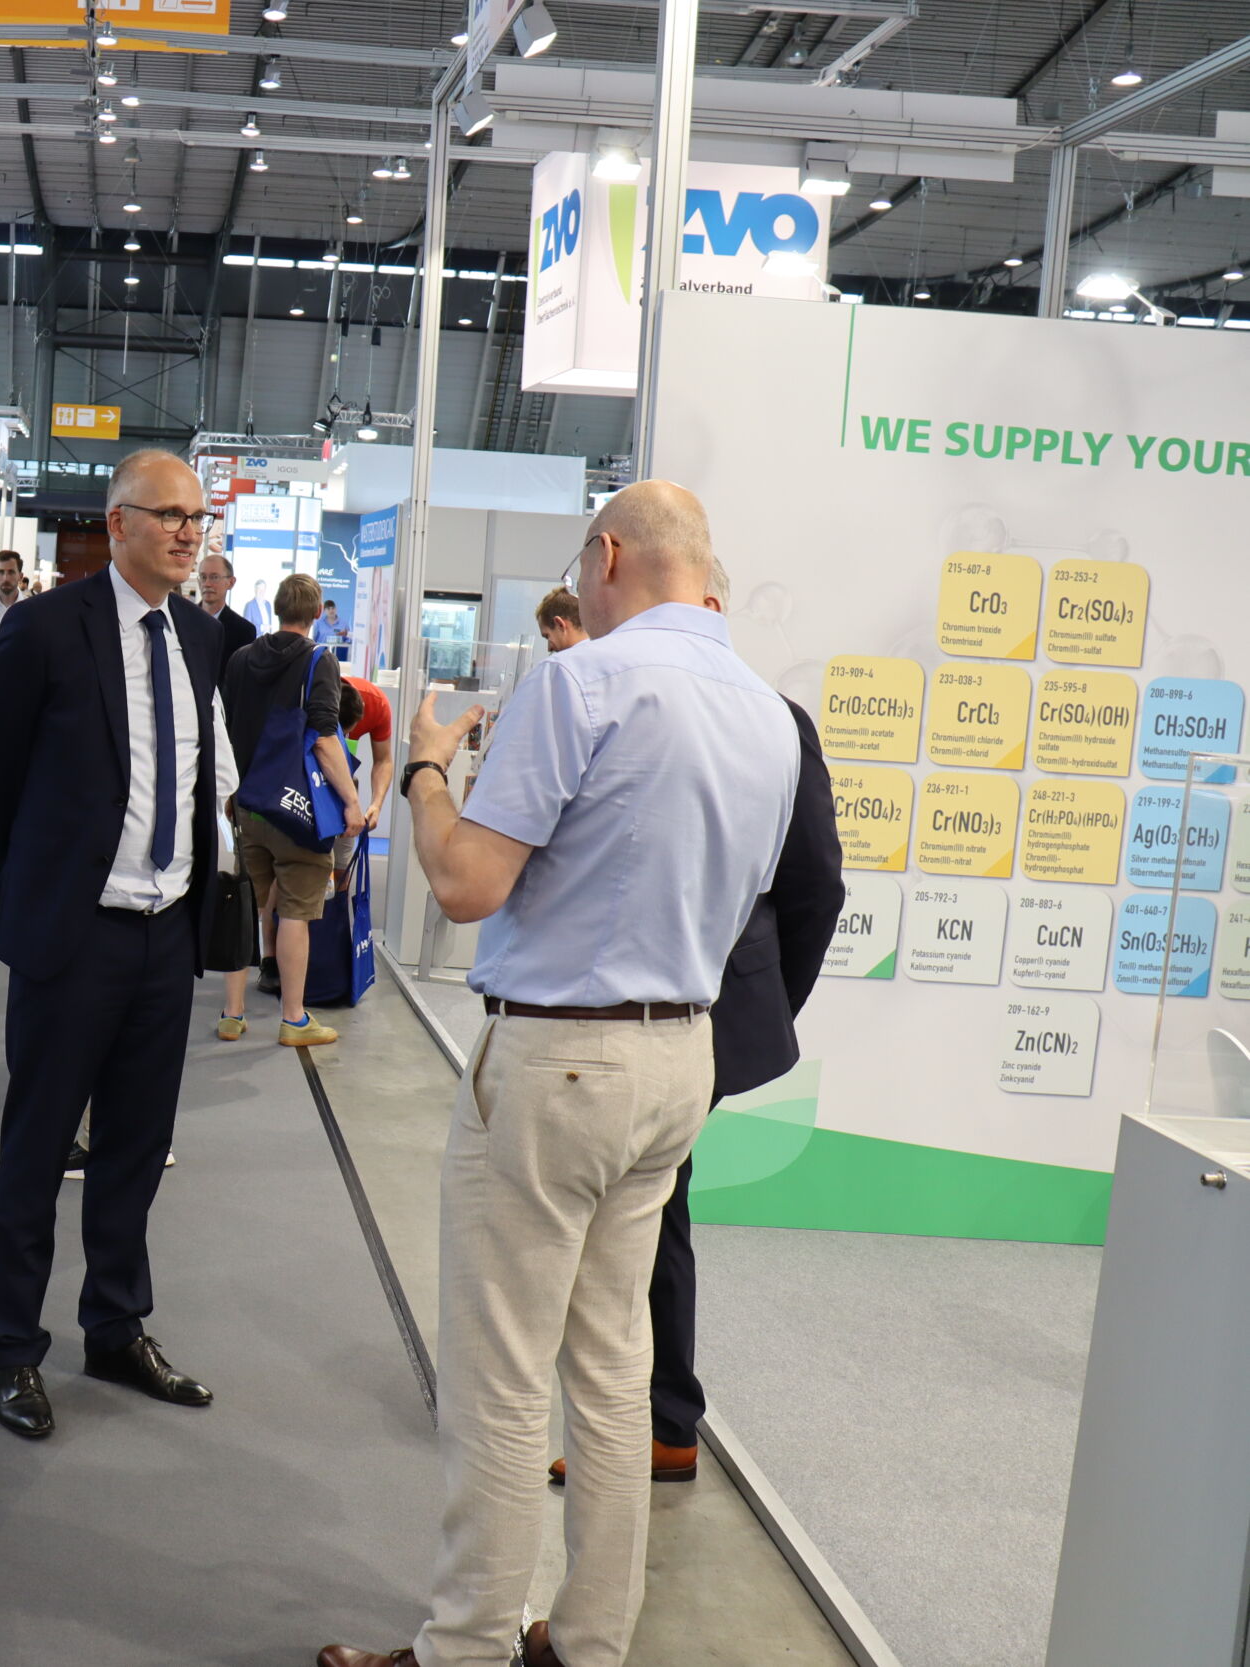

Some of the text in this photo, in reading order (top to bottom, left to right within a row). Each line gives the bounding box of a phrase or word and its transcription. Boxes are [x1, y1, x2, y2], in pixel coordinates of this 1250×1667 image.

[540, 188, 581, 273] ZVO
[860, 415, 1250, 477] WE SUPPLY YOUR
[246, 458, 268, 467] ZVO
[948, 562, 991, 575] 215-607-8
[1055, 570, 1098, 583] 233-253-2
[942, 622, 1001, 634] Chromium trioxide
[941, 636, 982, 647] Chromtrioxid
[1095, 632, 1117, 642] sulfate
[830, 666, 874, 678] 213-909-4
[939, 674, 982, 686] 233-038-3
[1044, 681, 1087, 693] 235-595-8
[1150, 688, 1193, 700] 200-898-6
[871, 728, 894, 738] acetate
[977, 734, 1004, 745] chloride
[1084, 734, 1116, 745] hydroxide
[1038, 743, 1060, 752] sulfate
[1144, 746, 1191, 757] Methanesulfon
[830, 777, 863, 789] 3-401-6
[927, 783, 969, 795] 236-921-1
[1032, 790, 1075, 803] 248-221-3
[1137, 796, 1181, 809] 219-199-2
[1133, 823, 1220, 850] Ag(O3CH3)
[849, 840, 871, 850] sulfate
[966, 844, 986, 854] nitrate
[1027, 841, 1090, 852] hydrogenphosphate
[1131, 855, 1150, 864] Silver
[1024, 864, 1084, 875] hydrogenphosphat
[915, 891, 958, 904] 205-792-3
[1020, 898, 1062, 910] 208-883-6
[1125, 904, 1168, 916] 401-640-7
[937, 918, 973, 942] KCN
[1036, 924, 1084, 948] CuCN
[829, 945, 854, 955] cyanide
[911, 949, 972, 962] Potassium cyanide
[910, 962, 954, 973] Kaliumcyanid
[1045, 957, 1070, 967] cyanide
[1008, 1004, 1050, 1016] 209-162-9
[1001, 1060, 1041, 1071] Zinc cyanide
[1000, 1073, 1035, 1084] Zinkcyanid
